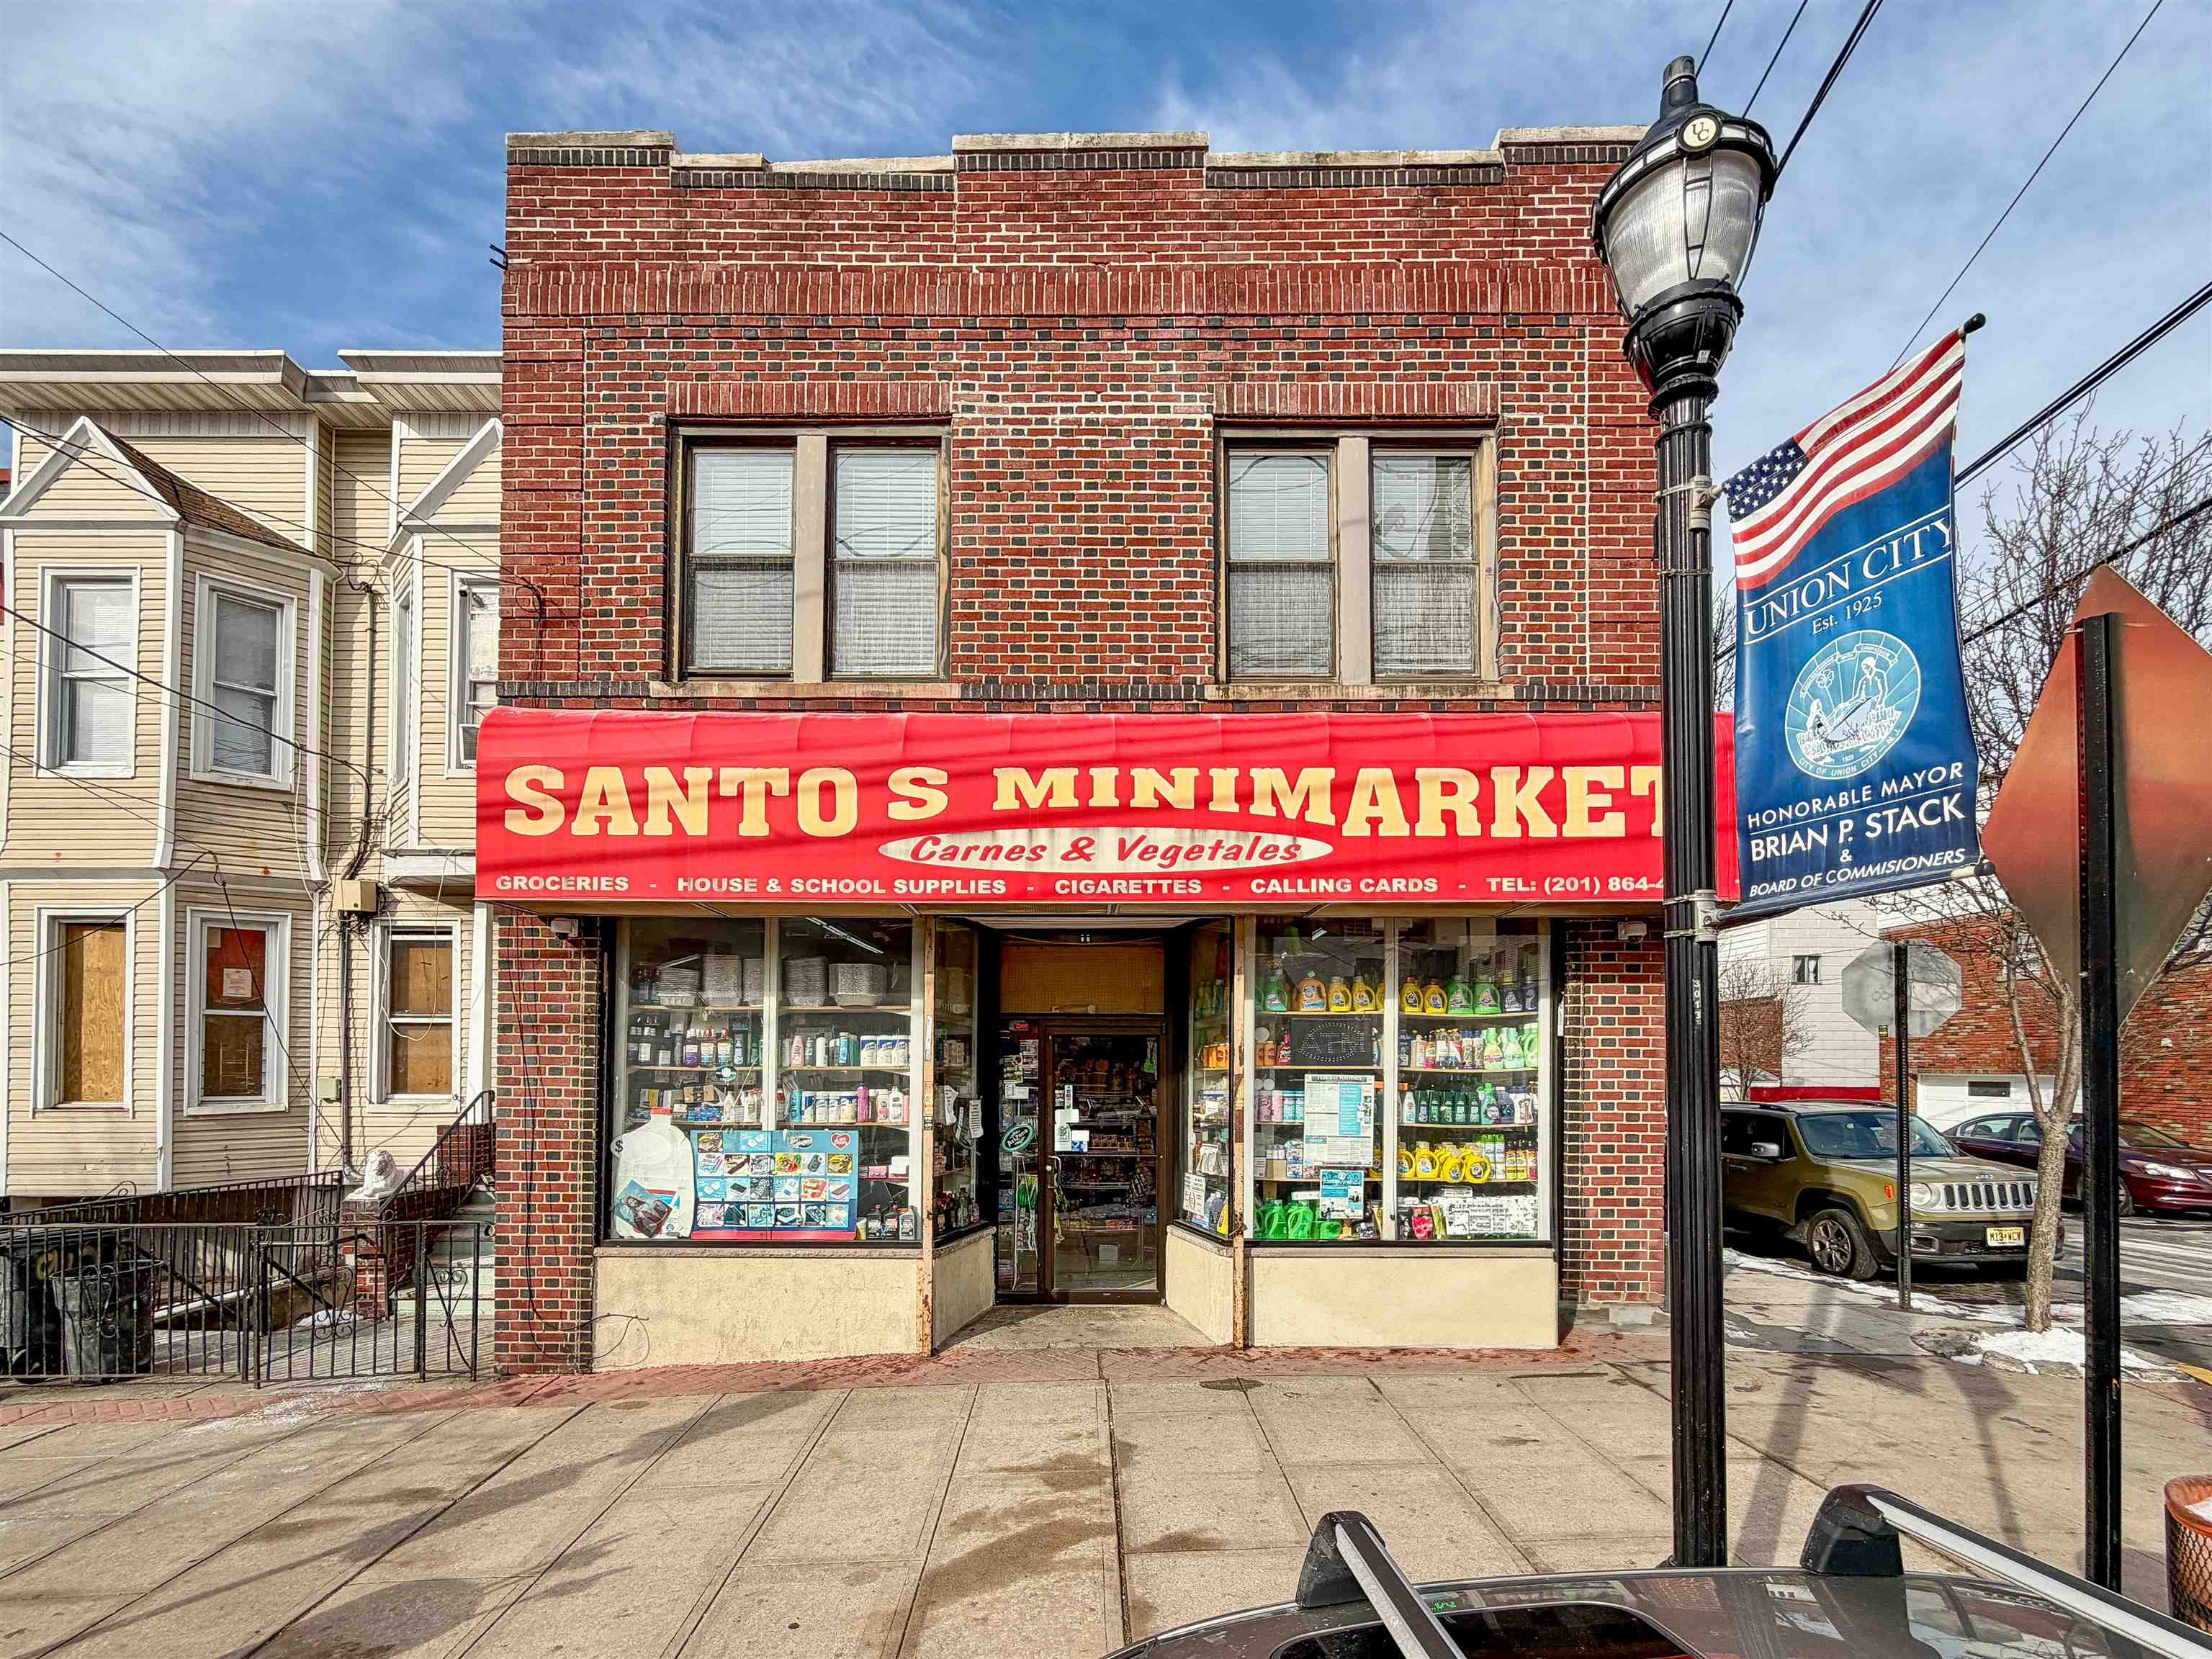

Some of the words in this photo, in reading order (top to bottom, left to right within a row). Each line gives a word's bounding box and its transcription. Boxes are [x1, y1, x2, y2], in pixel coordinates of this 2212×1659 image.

[1743, 561, 1851, 635] UNION
[1862, 518, 1952, 579] CITY
[1811, 613, 1838, 634] Est.
[1845, 590, 1884, 621] 1925
[1799, 757, 1815, 772] CITY
[1815, 766, 1827, 775] OF
[1831, 765, 1858, 777] UNION
[1860, 750, 1879, 768] CITY
[504, 765, 858, 837] SANTO
[888, 766, 948, 821] S
[1748, 785, 1871, 829] HONORABLE
[1881, 762, 1964, 797] MAYOR
[1750, 824, 1827, 863] BRIAN
[1838, 819, 1854, 844] P.
[1865, 793, 1965, 838] STACK
[910, 835, 1047, 862] Carnes
[1060, 836, 1095, 862] &
[1118, 835, 1301, 869] Vegetales
[1750, 878, 1797, 897] BOARD
[1800, 873, 1823, 888] OF
[1825, 848, 1966, 884] COMMISIONERS
[1839, 849, 1853, 863] &
[495, 876, 629, 891] GROCERIES
[678, 877, 757, 893] HOUSE
[765, 878, 783, 893] &
[790, 878, 886, 894] SCHOOL
[893, 878, 1007, 894] SUPPLIES
[1055, 879, 1202, 894] CIGARETTES
[1251, 878, 1352, 894] CALLING
[1359, 878, 1438, 893] CARDS
[1485, 877, 1537, 892] TEL:
[1544, 876, 1601, 895] (201)
[614, 1140, 624, 1153] $
